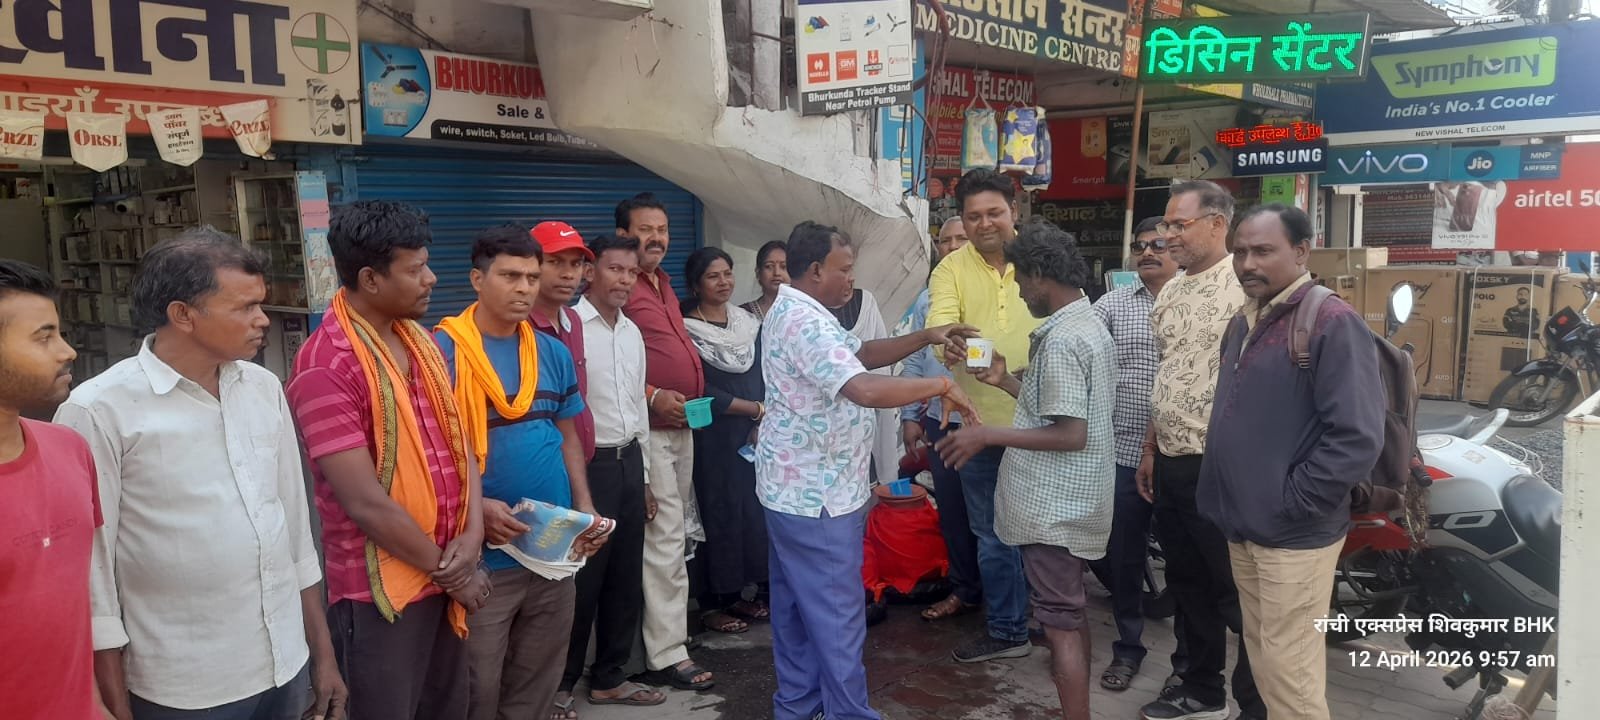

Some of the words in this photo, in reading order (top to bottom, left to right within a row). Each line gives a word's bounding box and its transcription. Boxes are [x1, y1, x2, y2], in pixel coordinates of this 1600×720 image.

[915, 4, 1039, 55] MEDICINE
[1044, 37, 1121, 72] CENTRE
[1145, 25, 1262, 73] डिसिन
[1272, 22, 1362, 71] सेंटर
[1395, 54, 1540, 88] Symphony
[808, 91, 853, 102] Bhurkunda
[856, 87, 886, 97] Tracker
[888, 82, 911, 93] Stand
[973, 74, 1033, 104] TELECOM
[497, 104, 529, 119] Sale
[534, 107, 545, 119] &
[826, 101, 846, 111] Near
[847, 97, 872, 108] Petrol
[874, 96, 896, 107] Pump
[1385, 101, 1440, 119] India's
[1445, 98, 1487, 114] No.1
[1492, 93, 1556, 112] Cooler
[440, 126, 463, 137] wire,
[465, 128, 498, 139] switch,
[529, 132, 545, 142] Led
[1151, 126, 1190, 139] Smooth
[1436, 128, 1464, 136] VISHAL
[1466, 125, 1506, 134] TELECOM
[1237, 148, 1322, 168] SAMSUNG
[1337, 149, 1428, 175] vivo
[1466, 155, 1493, 174] Jio
[1530, 152, 1551, 160] MNP
[1513, 189, 1573, 208] airtel
